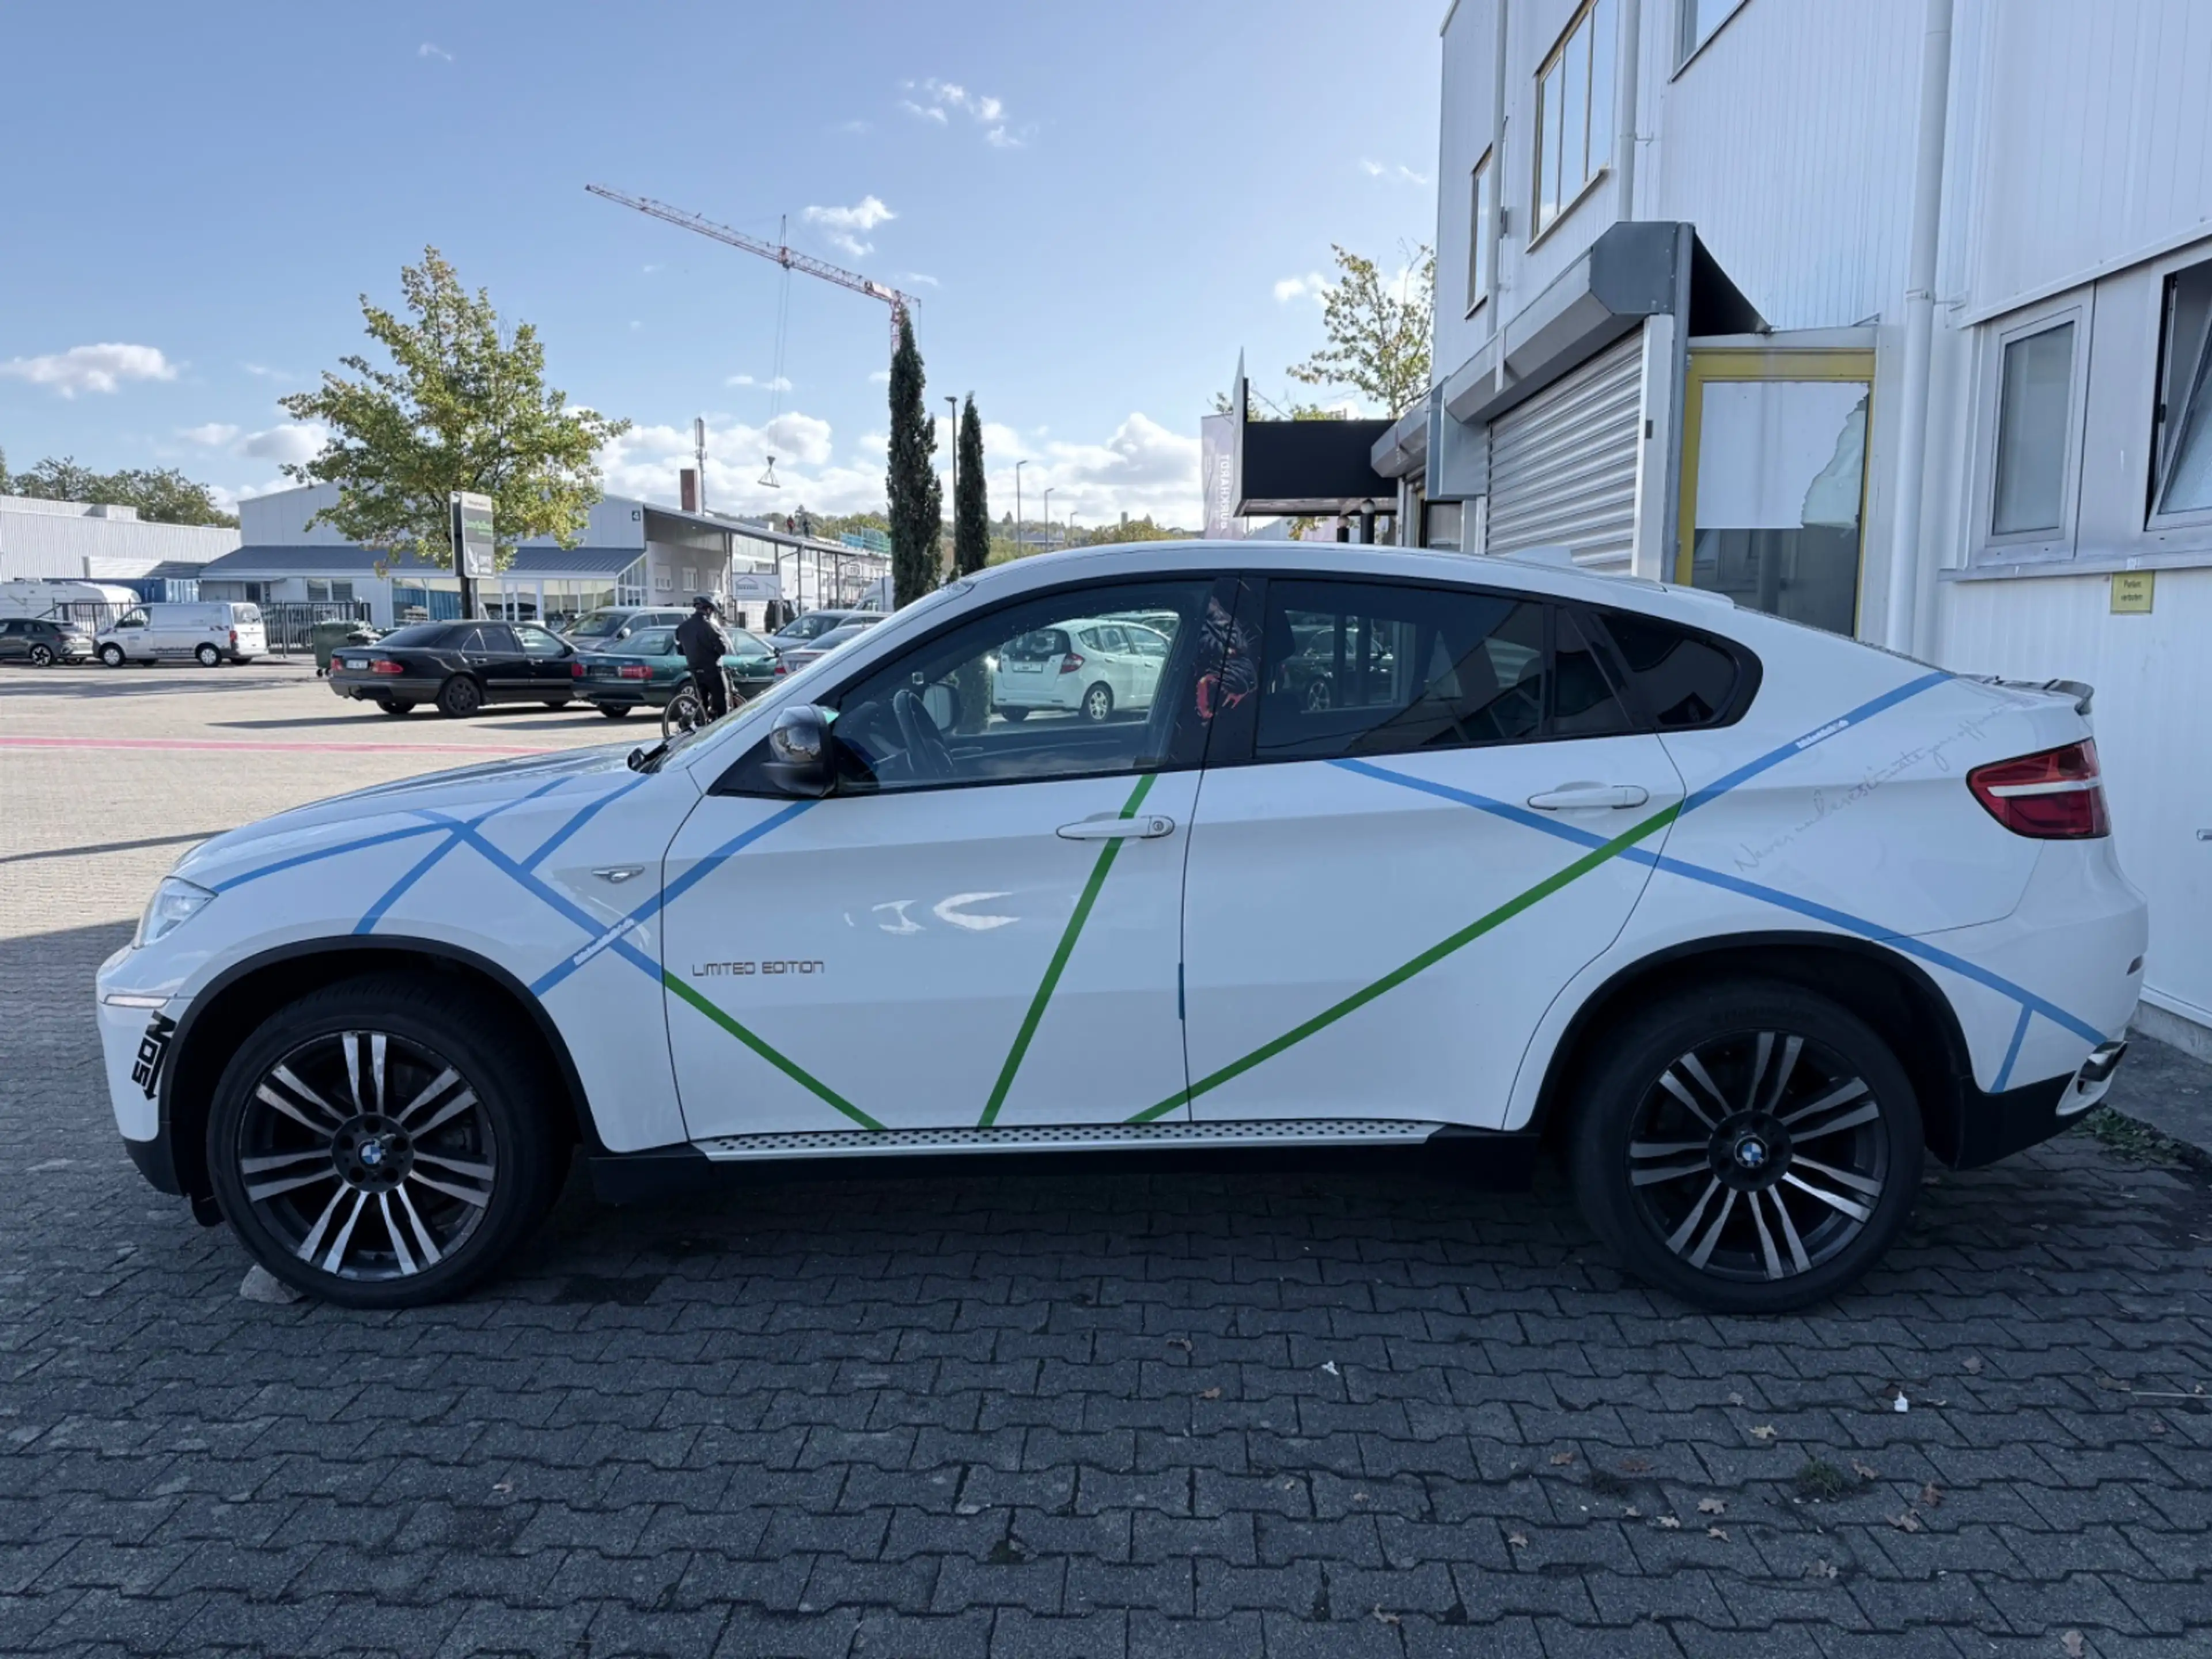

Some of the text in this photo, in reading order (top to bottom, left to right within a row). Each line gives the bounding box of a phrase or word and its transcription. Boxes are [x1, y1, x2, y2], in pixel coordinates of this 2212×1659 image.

[692, 960, 825, 977] LIMITED EDITION
[131, 1009, 177, 1101] NOS
